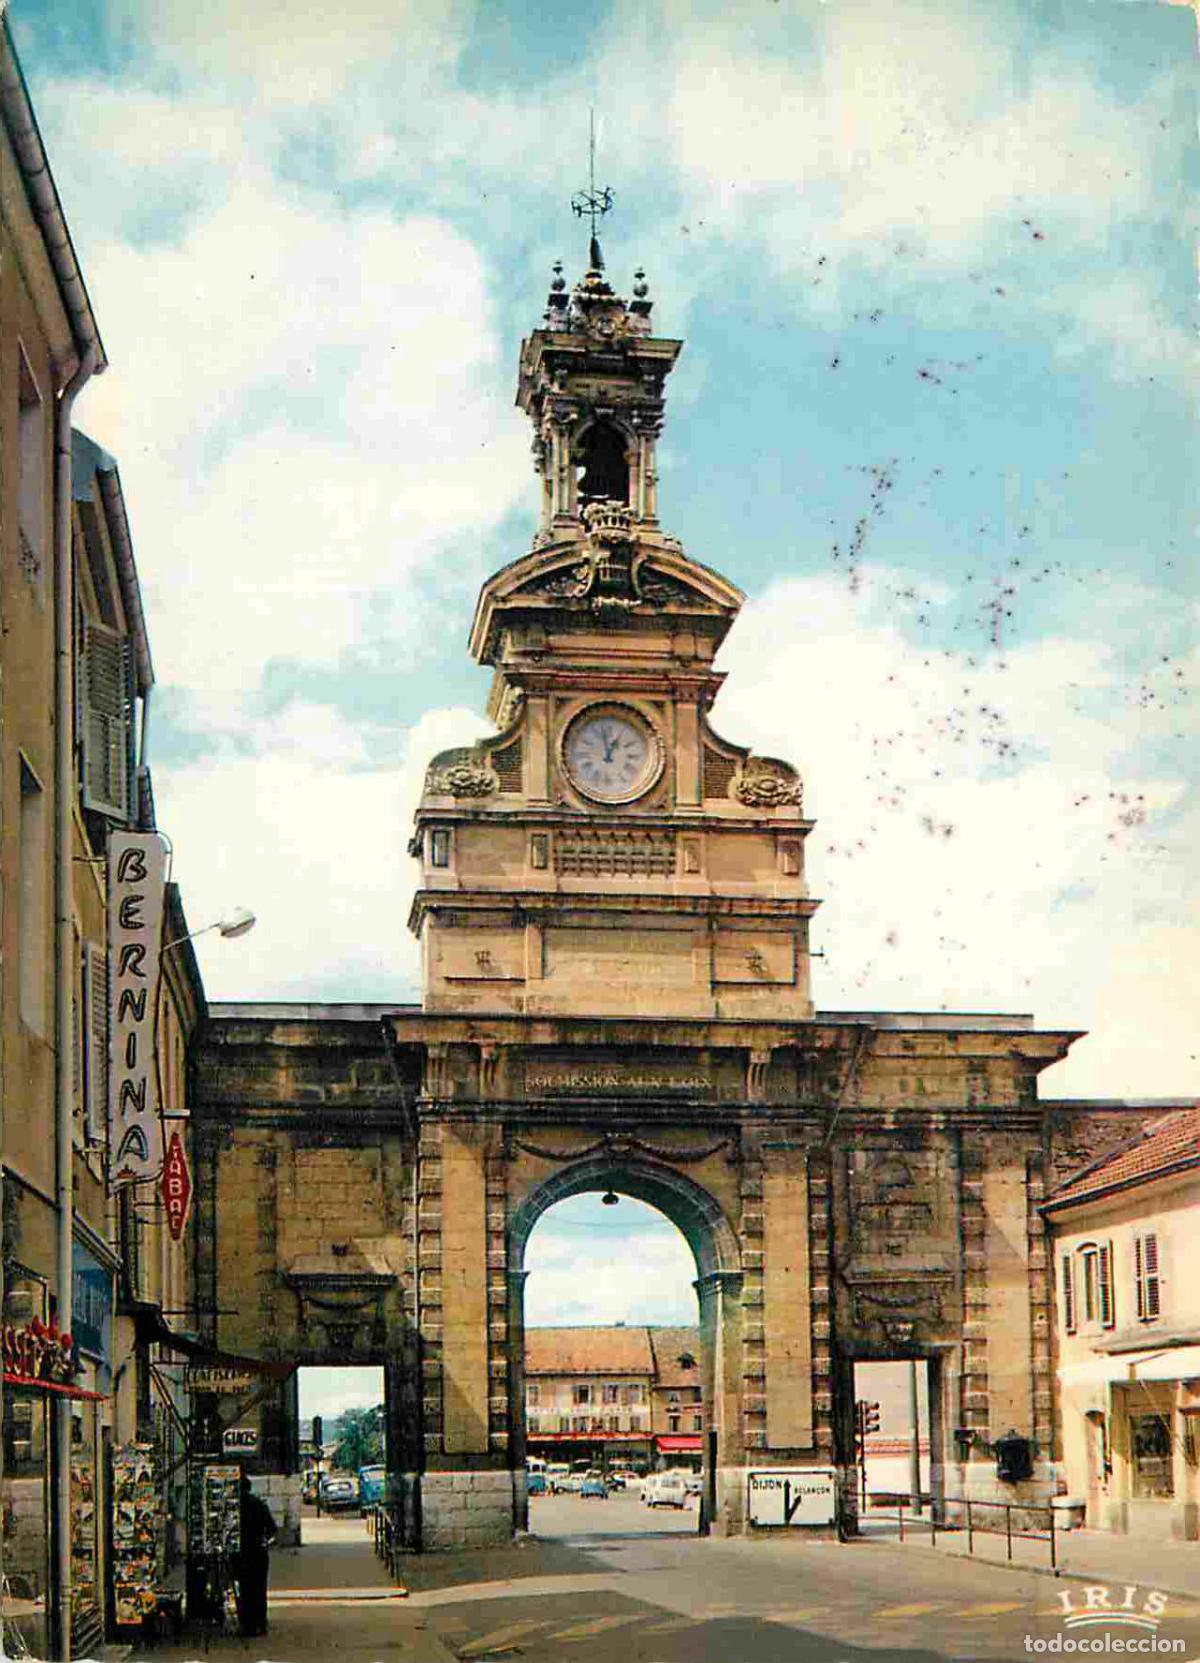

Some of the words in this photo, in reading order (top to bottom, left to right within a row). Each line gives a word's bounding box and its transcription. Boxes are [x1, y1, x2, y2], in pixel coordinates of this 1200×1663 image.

[117, 848, 148, 1161] BERNINA
[169, 1145, 182, 1229] TABAC
[752, 1480, 782, 1490] DIJON
